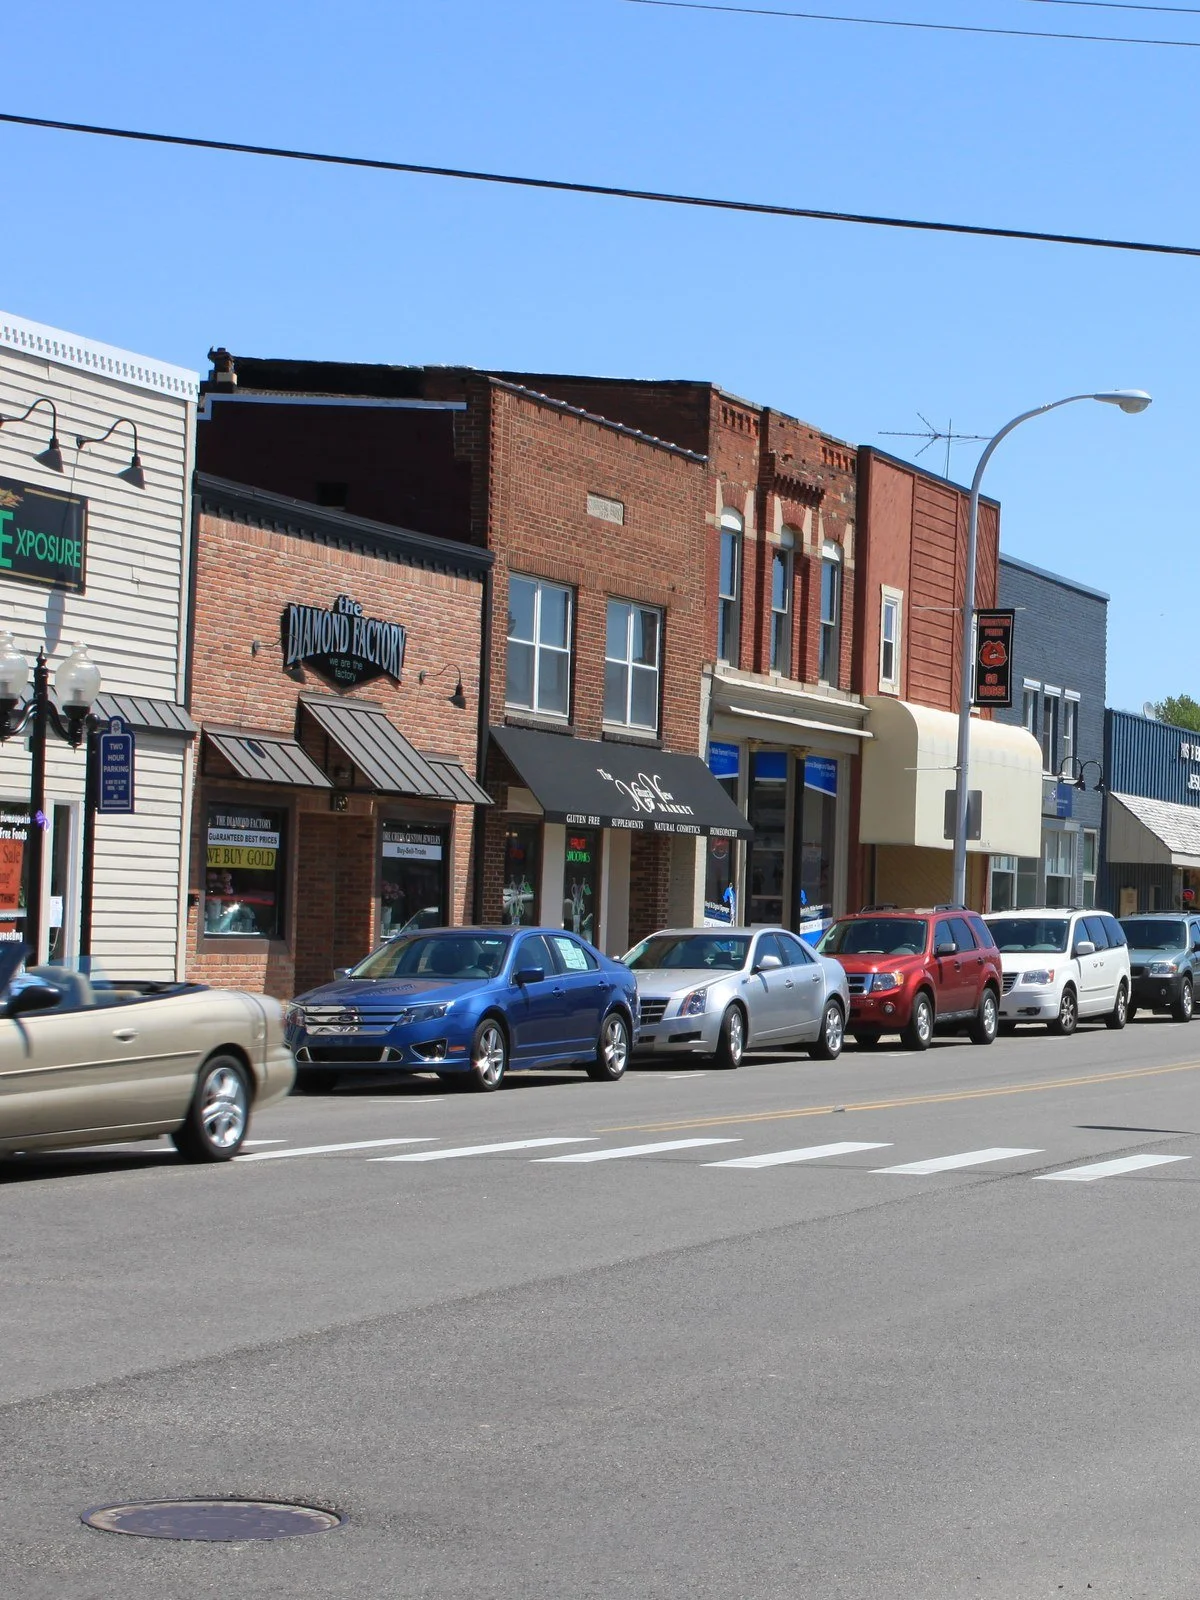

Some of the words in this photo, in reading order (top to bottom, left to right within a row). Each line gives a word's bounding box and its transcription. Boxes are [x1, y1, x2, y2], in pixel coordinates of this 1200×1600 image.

[338, 596, 363, 617] the
[287, 605, 350, 665] DIAMOND
[352, 617, 406, 680] FACTORY
[329, 658, 338, 667] we
[341, 660, 351, 668] are
[353, 660, 364, 670] the
[335, 669, 357, 681] factory
[109, 743, 123, 751] TWO
[597, 769, 614, 780] The
[657, 803, 695, 815] MARKET
[216, 815, 226, 826] THE
[227, 816, 249, 828] DIAMOND
[250, 818, 271, 829] FACTORY
[566, 814, 587, 824] GLUTEN
[588, 816, 600, 825] FREE
[612, 818, 644, 829] SUPPLEMENTS
[654, 822, 675, 832] NATURAL
[676, 824, 700, 834] COSMETICS
[710, 827, 738, 837] HOMEOPATHY
[209, 832, 245, 842] GUARANTEED
[245, 835, 259, 843] BEST
[260, 836, 278, 844] PRICES
[208, 847, 221, 863] WE
[223, 848, 243, 865] BUY
[247, 849, 274, 867] GOLD
